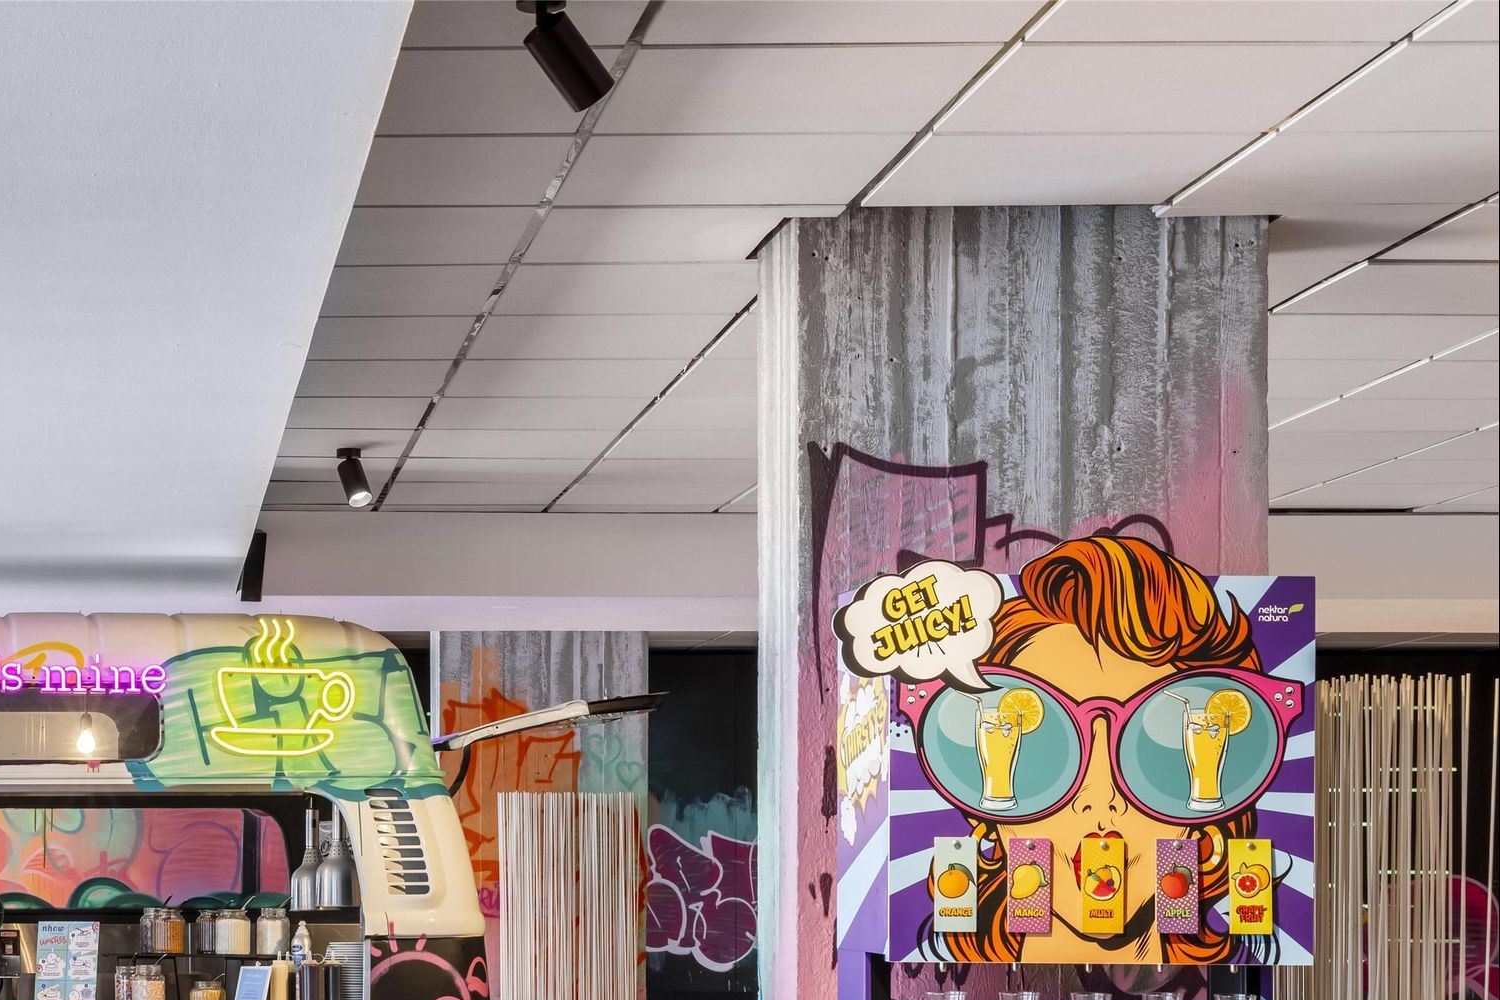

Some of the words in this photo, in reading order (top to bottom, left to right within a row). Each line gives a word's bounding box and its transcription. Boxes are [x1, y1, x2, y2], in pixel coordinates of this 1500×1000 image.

[882, 574, 939, 622] GET
[1258, 605, 1288, 614] nektar
[1258, 613, 1289, 622] natura
[871, 594, 978, 661] JUICY!
[40, 653, 167, 694] mine
[938, 908, 973, 917] ORANGE
[1014, 908, 1045, 917] MANGO
[1089, 908, 1114, 919] MULTI
[1164, 909, 1192, 919] APPLE
[1239, 914, 1264, 923] FRUIT
[42, 924, 65, 932] nhow
